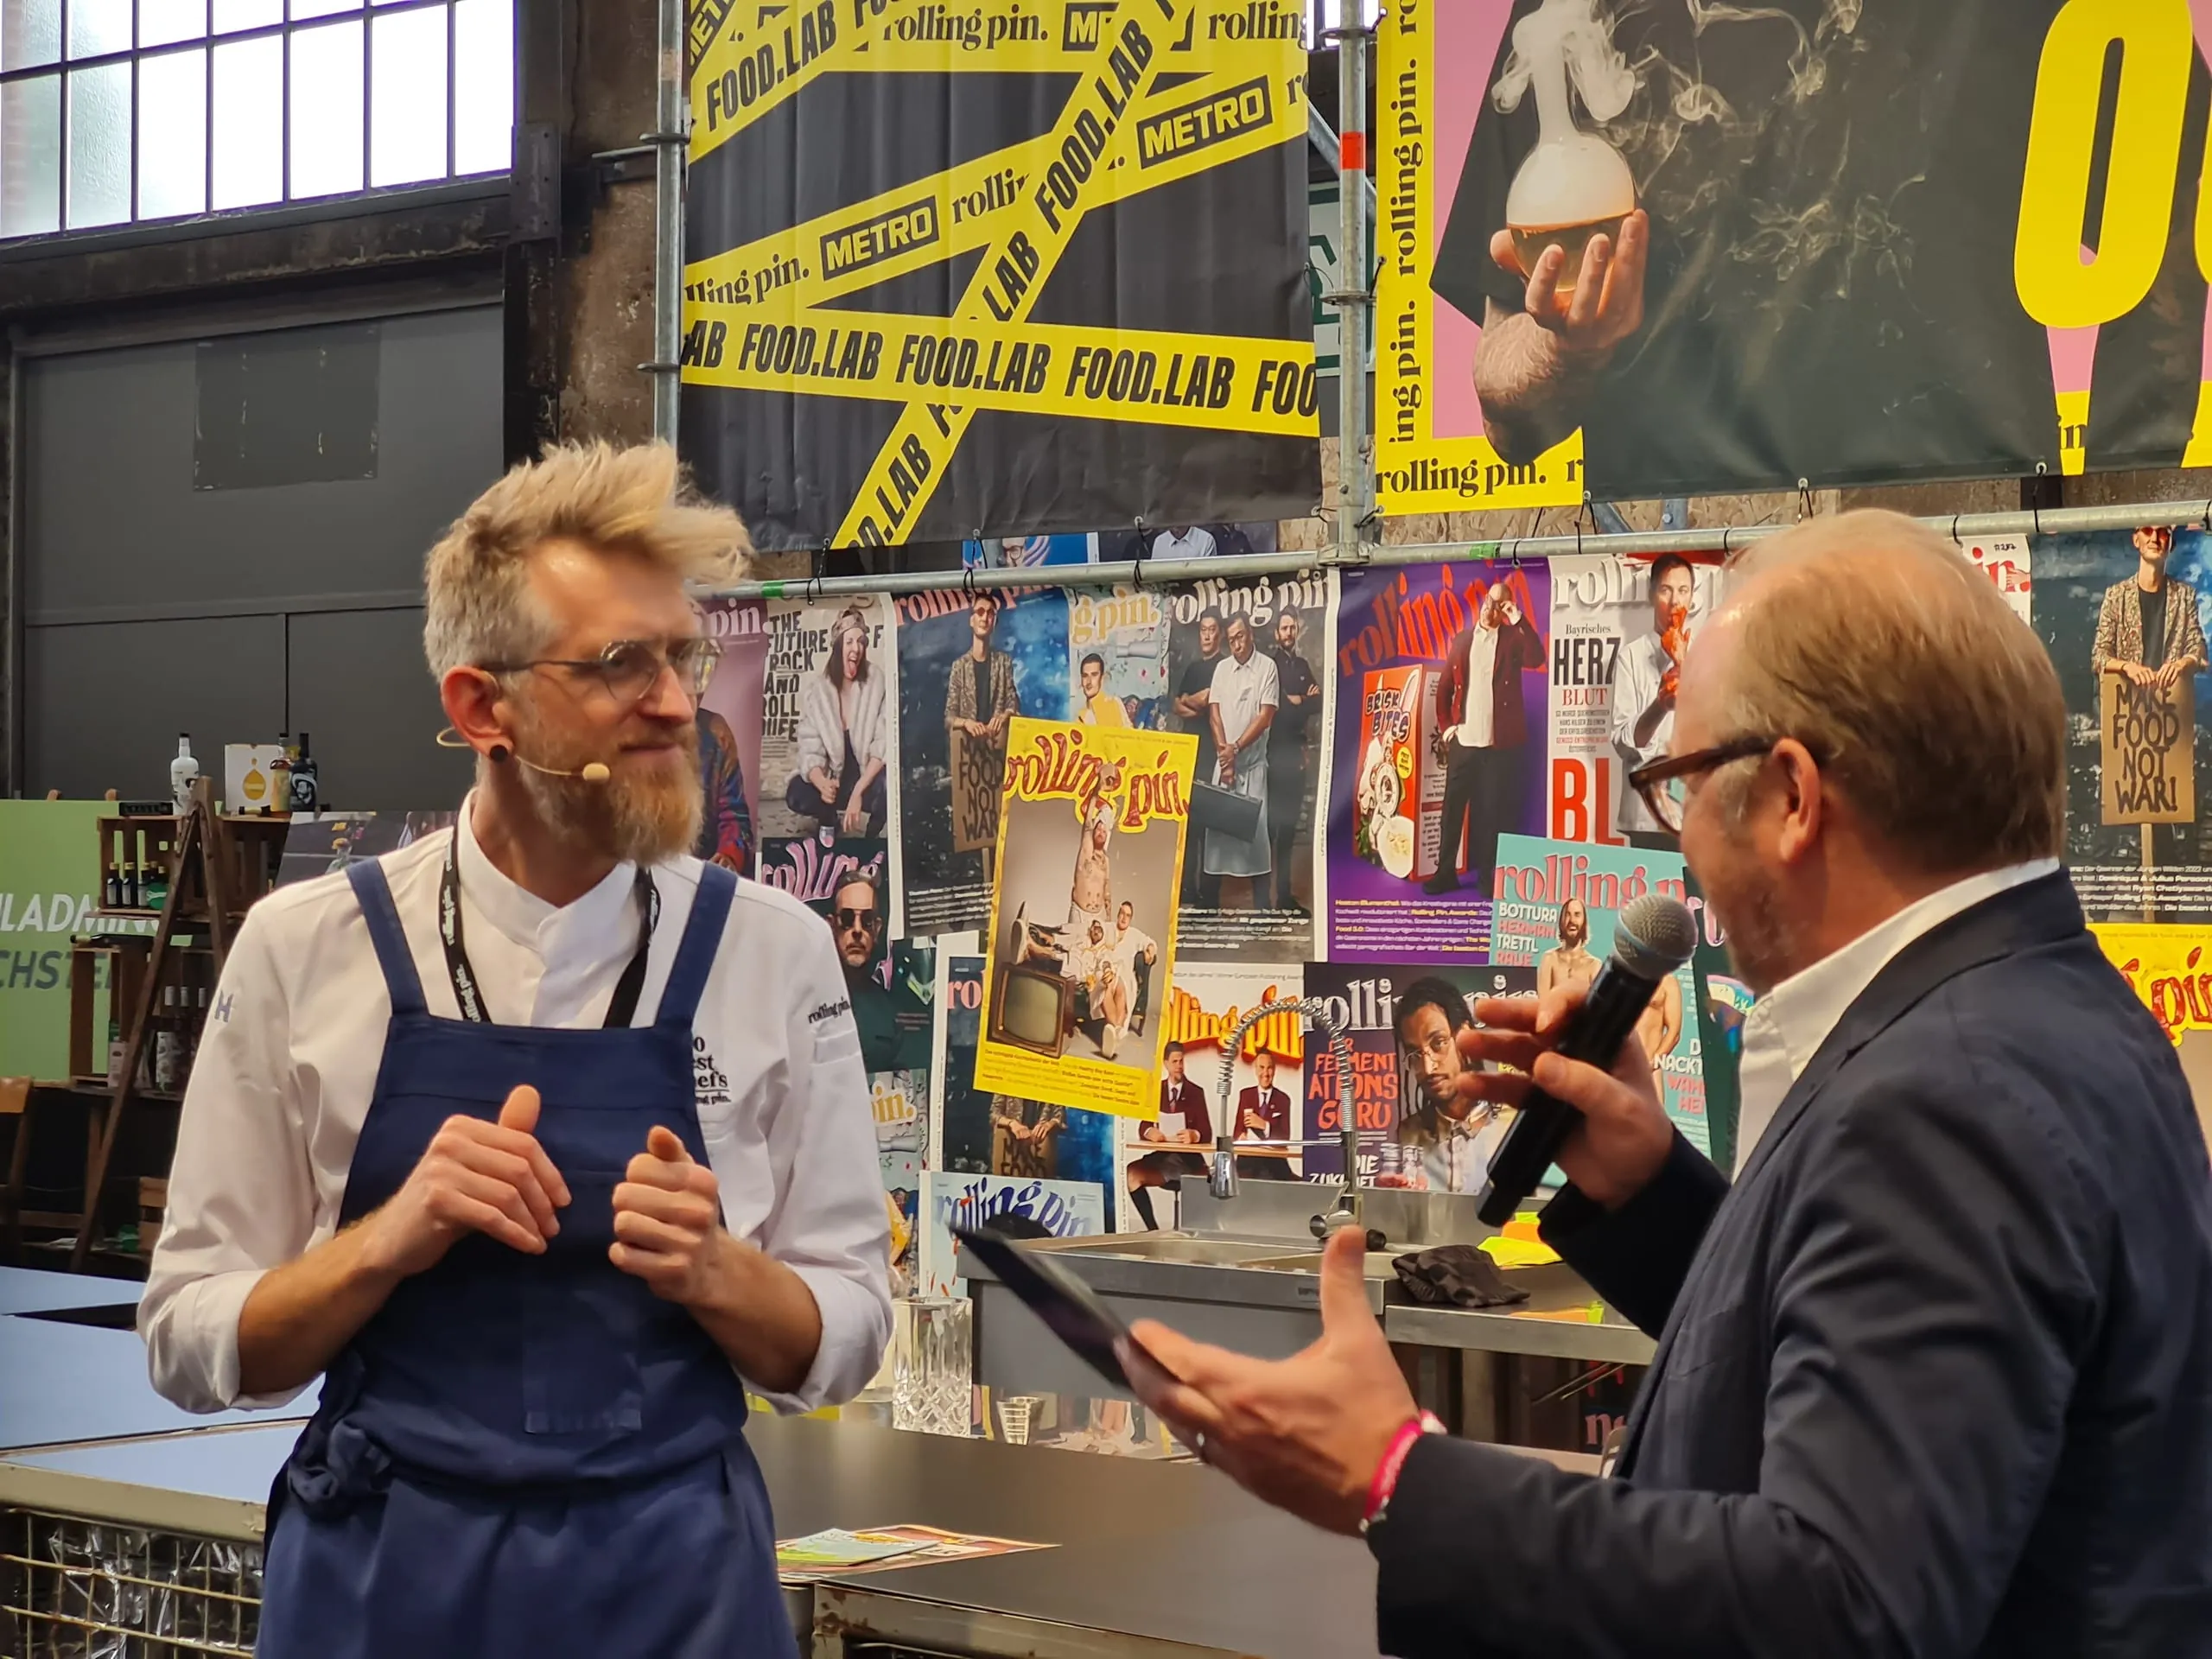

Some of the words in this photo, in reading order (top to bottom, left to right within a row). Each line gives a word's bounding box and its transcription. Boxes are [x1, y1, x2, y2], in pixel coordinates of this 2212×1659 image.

[988, 4, 1049, 50] pin.
[706, 0, 837, 132] FOOD.LAB
[1390, 59, 1422, 138] pin.
[1034, 19, 1154, 235] FOOD.LAB
[1144, 86, 1265, 159] METRO
[952, 168, 1029, 226] rolli
[1390, 142, 1423, 278] rolling
[825, 206, 933, 271] METRO
[753, 254, 810, 302] pin.
[1389, 300, 1421, 380] pin.
[738, 323, 883, 380] FOOD.LAB
[895, 334, 1052, 392] FOOD.LAB
[1065, 346, 1236, 410] FOOD.LAB
[1376, 457, 1478, 499] rolling
[769, 611, 802, 633] THE
[1566, 623, 1611, 637] Bayrisches
[769, 648, 814, 672] ROCK
[1366, 690, 1400, 714] BRISK
[1561, 687, 1608, 707] BLUT
[1372, 710, 1410, 741] BITES
[2113, 711, 2181, 750] FOOD
[2122, 744, 2171, 781] NOT
[2114, 776, 2178, 815] WAR!
[1499, 902, 1558, 924] BOTTURA
[1497, 935, 1539, 953] TRETTL
[1318, 1101, 1393, 1130] GRU
